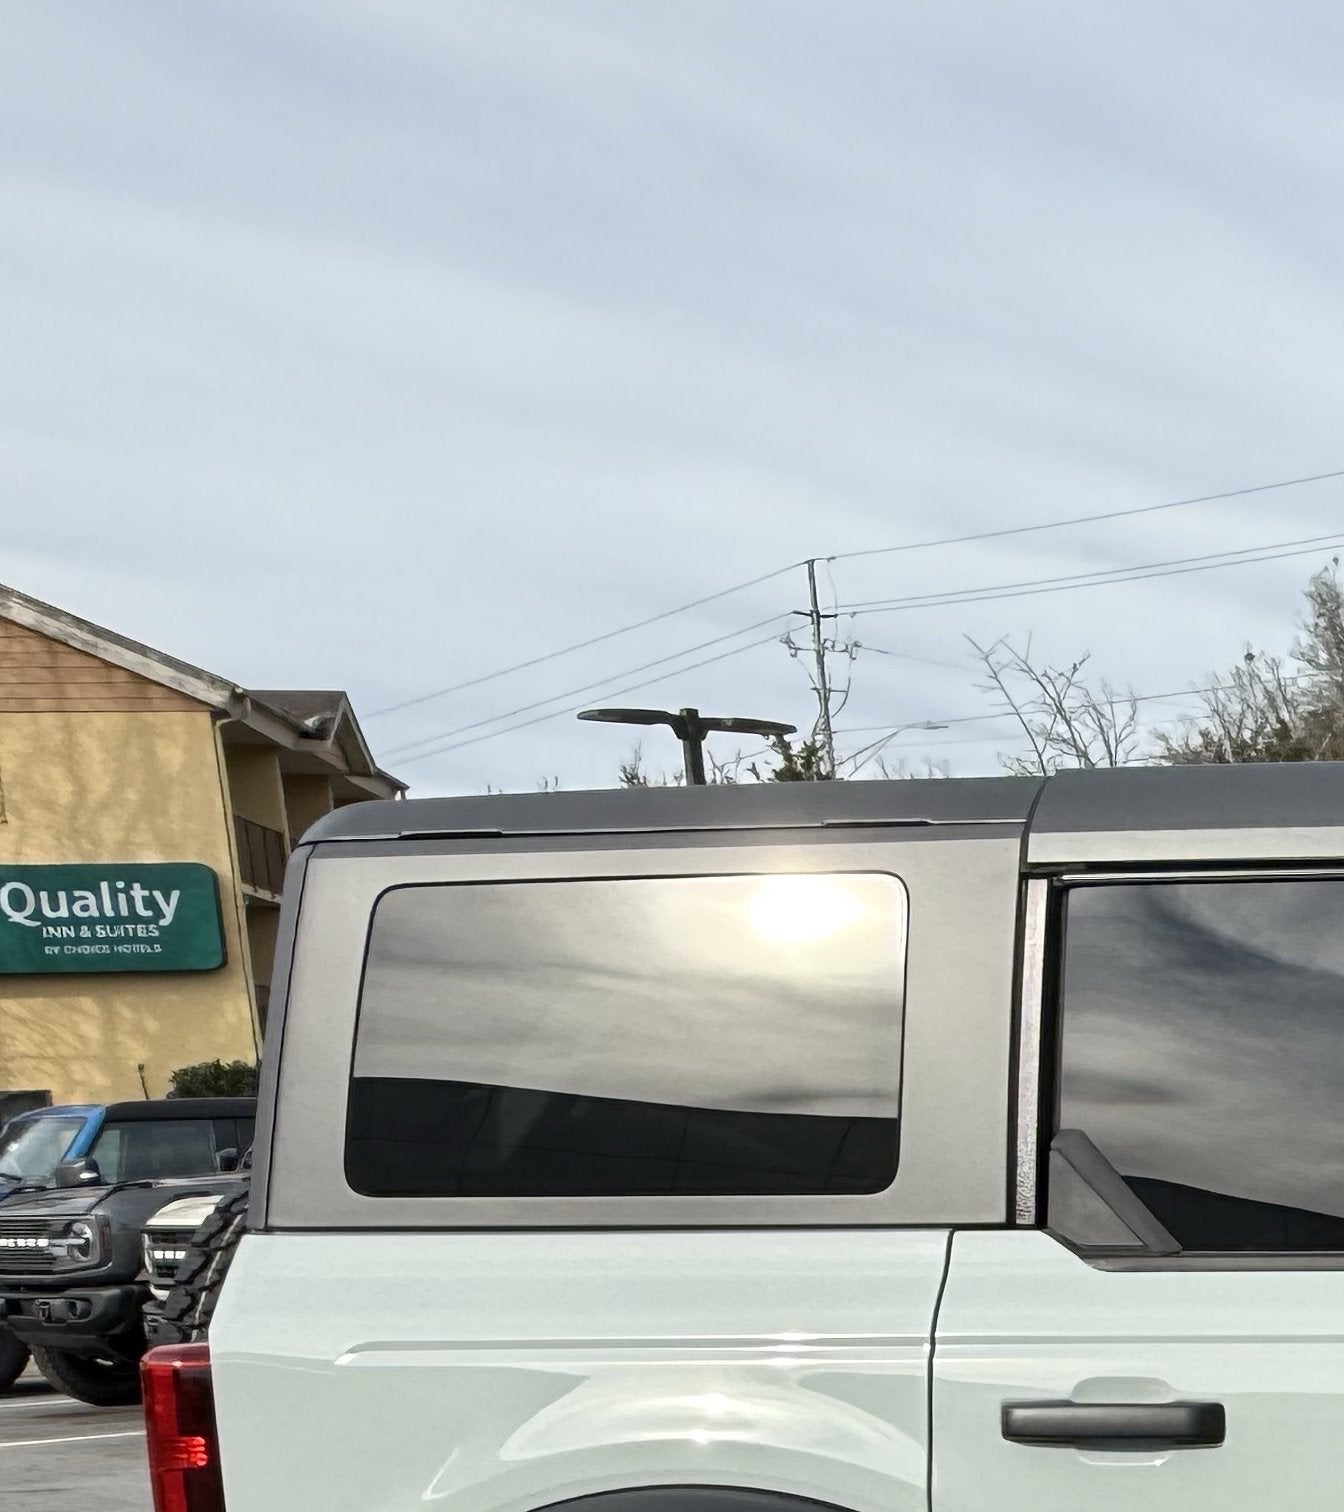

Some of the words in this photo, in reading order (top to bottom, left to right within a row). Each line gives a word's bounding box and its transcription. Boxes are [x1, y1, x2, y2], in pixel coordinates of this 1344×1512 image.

[0, 881, 181, 927] Quality
[42, 925, 76, 938] INN
[79, 924, 92, 938] &
[95, 924, 160, 938] SUITES
